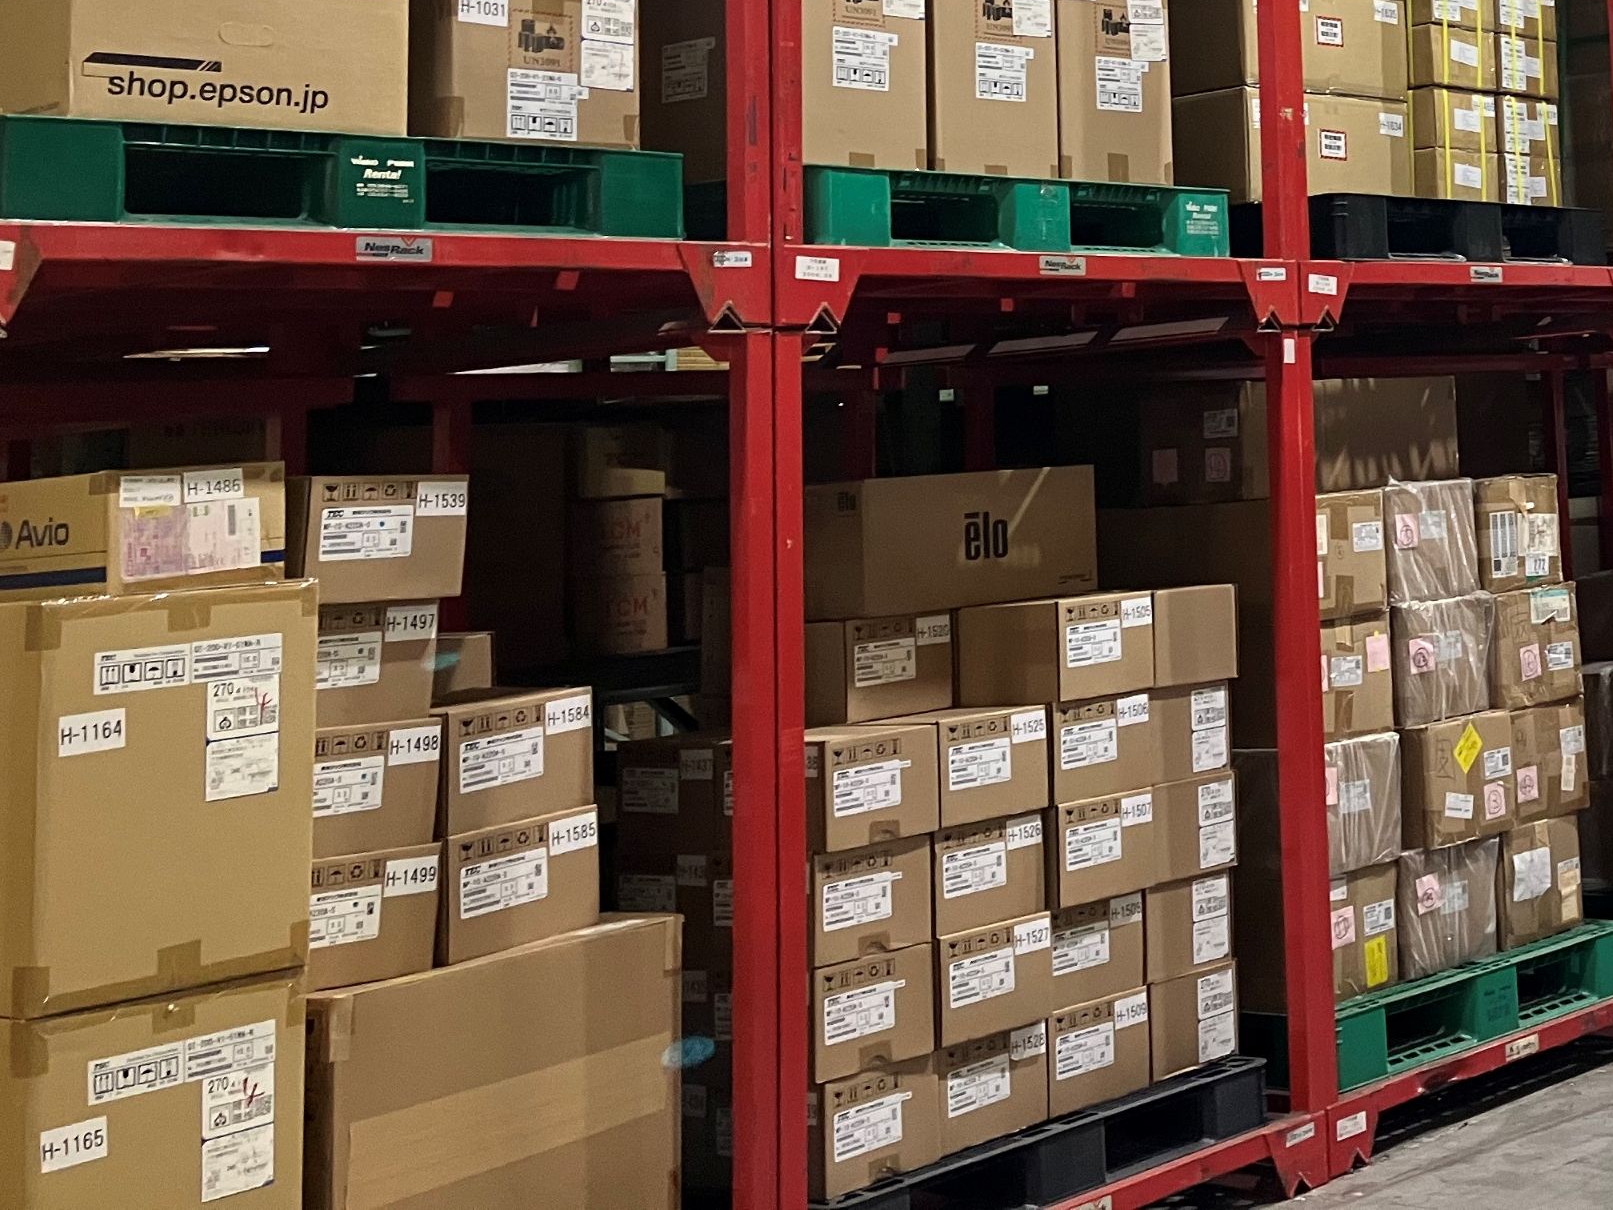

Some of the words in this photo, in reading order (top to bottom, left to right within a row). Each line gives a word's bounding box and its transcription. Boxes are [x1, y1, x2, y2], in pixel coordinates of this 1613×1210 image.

[107, 71, 329, 114] shop.epson.jp
[187, 477, 241, 496] H-1486
[418, 493, 466, 509] H-1539
[15, 517, 70, 551] Avio
[386, 613, 435, 632] H-1497
[213, 682, 234, 698] 270
[548, 704, 590, 727] H-1584
[60, 719, 122, 745] H-1164
[390, 735, 439, 755] H-1498
[552, 822, 596, 846] H-1585
[386, 865, 437, 887] H-1499
[208, 1077, 229, 1093] 270
[42, 1128, 104, 1161] H-1165
